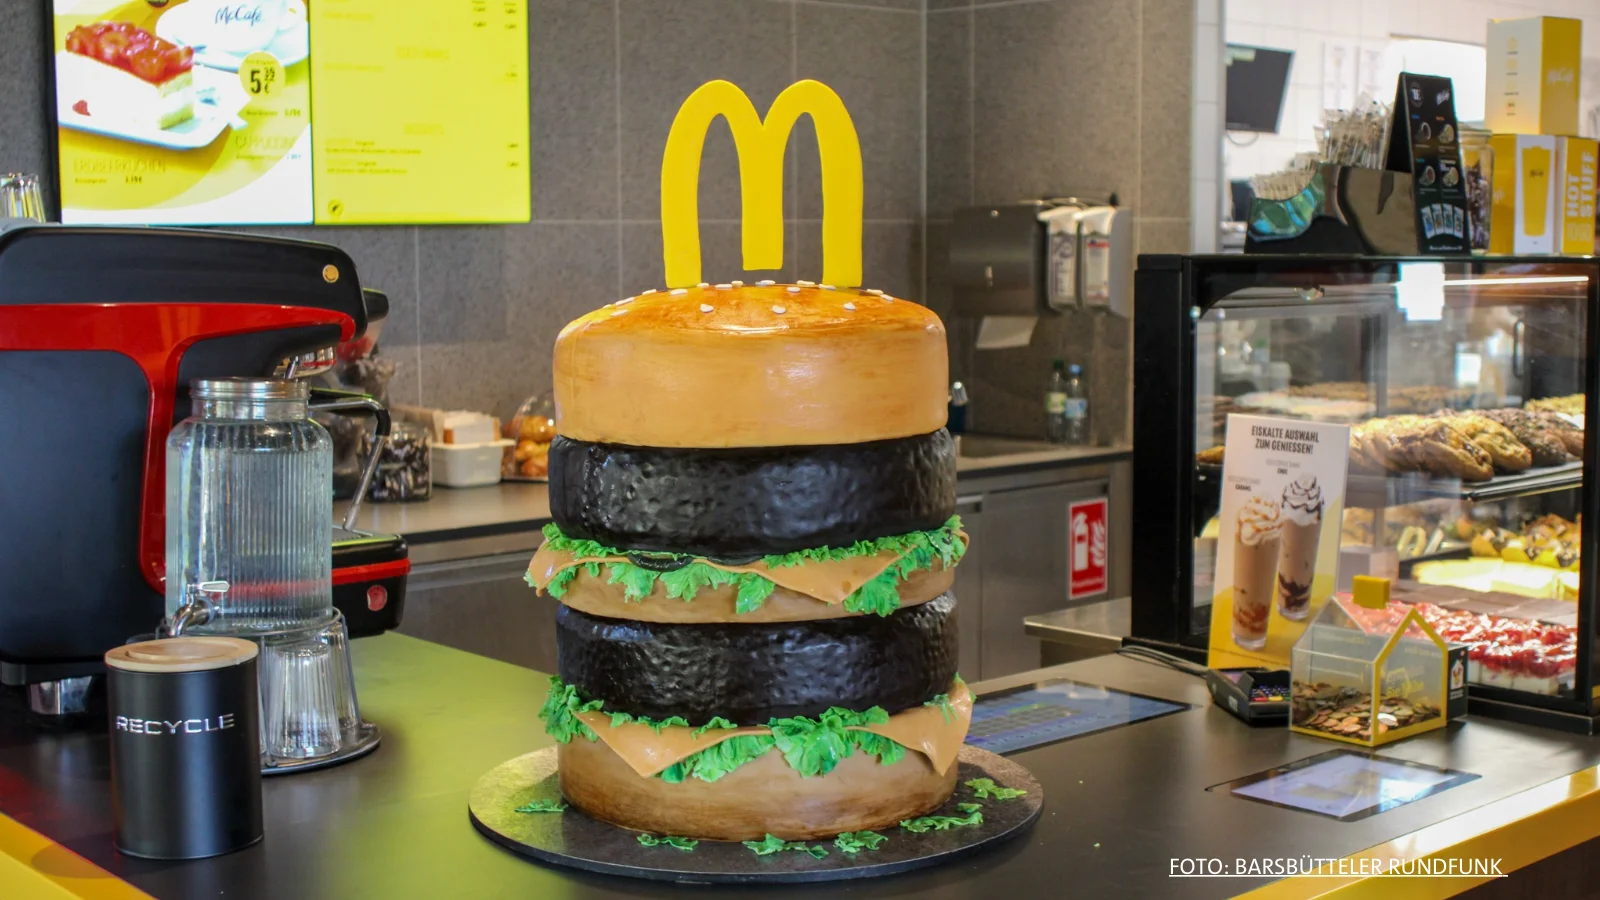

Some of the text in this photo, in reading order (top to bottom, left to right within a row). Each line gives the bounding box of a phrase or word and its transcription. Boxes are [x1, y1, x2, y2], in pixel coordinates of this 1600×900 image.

[250, 69, 262, 94] 5
[1567, 174, 1580, 217] HOT
[1580, 152, 1595, 218] STUFF
[1251, 425, 1319, 443] EISKALTE AUSWAHL
[1255, 438, 1314, 455] ZUM GENIESSEN!
[116, 713, 235, 735] RECYCLE
